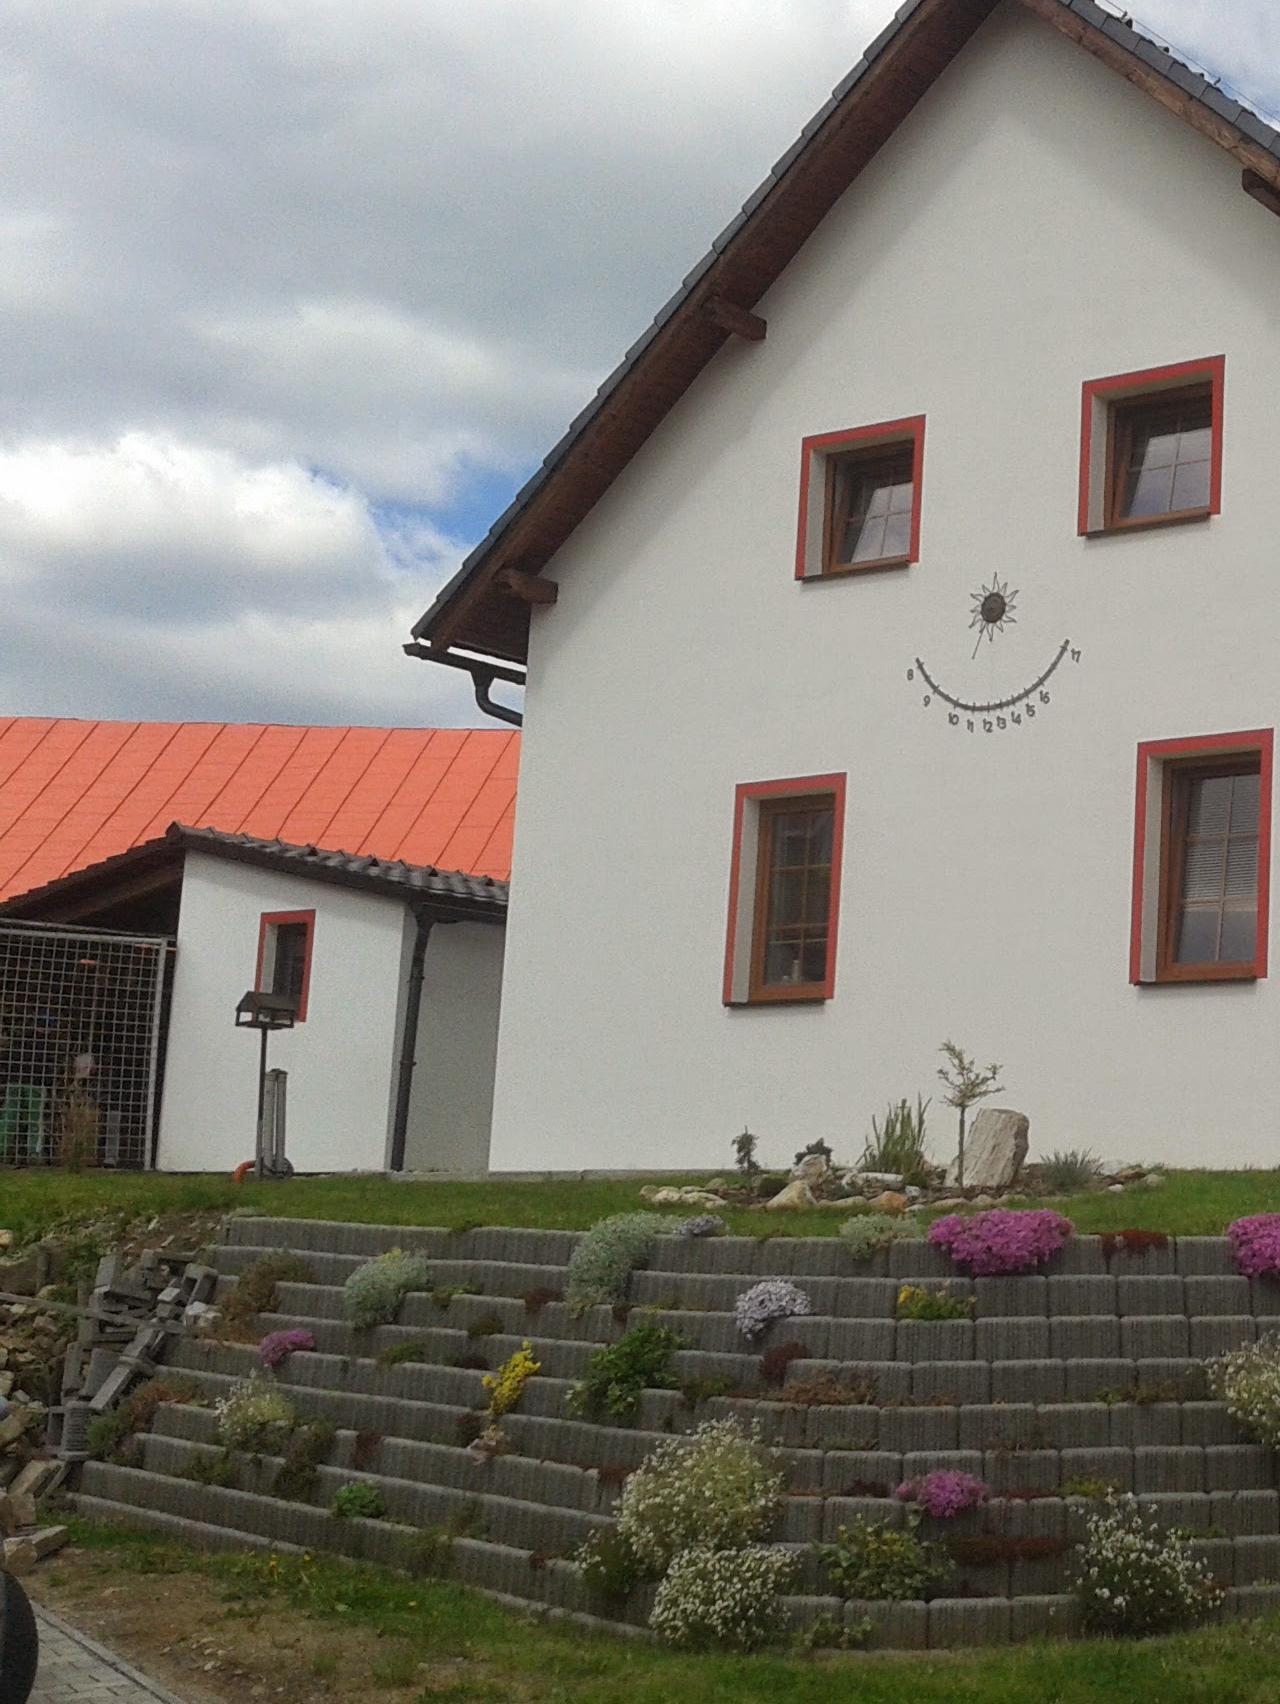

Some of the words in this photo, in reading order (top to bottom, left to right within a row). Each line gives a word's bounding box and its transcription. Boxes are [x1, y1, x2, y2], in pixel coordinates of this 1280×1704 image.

[906, 668, 915, 682] 8
[922, 694, 932, 708] 9
[947, 711, 960, 727] 10
[965, 718, 975, 734] 11
[981, 717, 994, 734] 12
[995, 714, 1008, 731] 13
[1010, 710, 1023, 727] 14
[1024, 702, 1037, 718] 15
[1038, 689, 1051, 705] 16
[1070, 647, 1082, 664] 17
